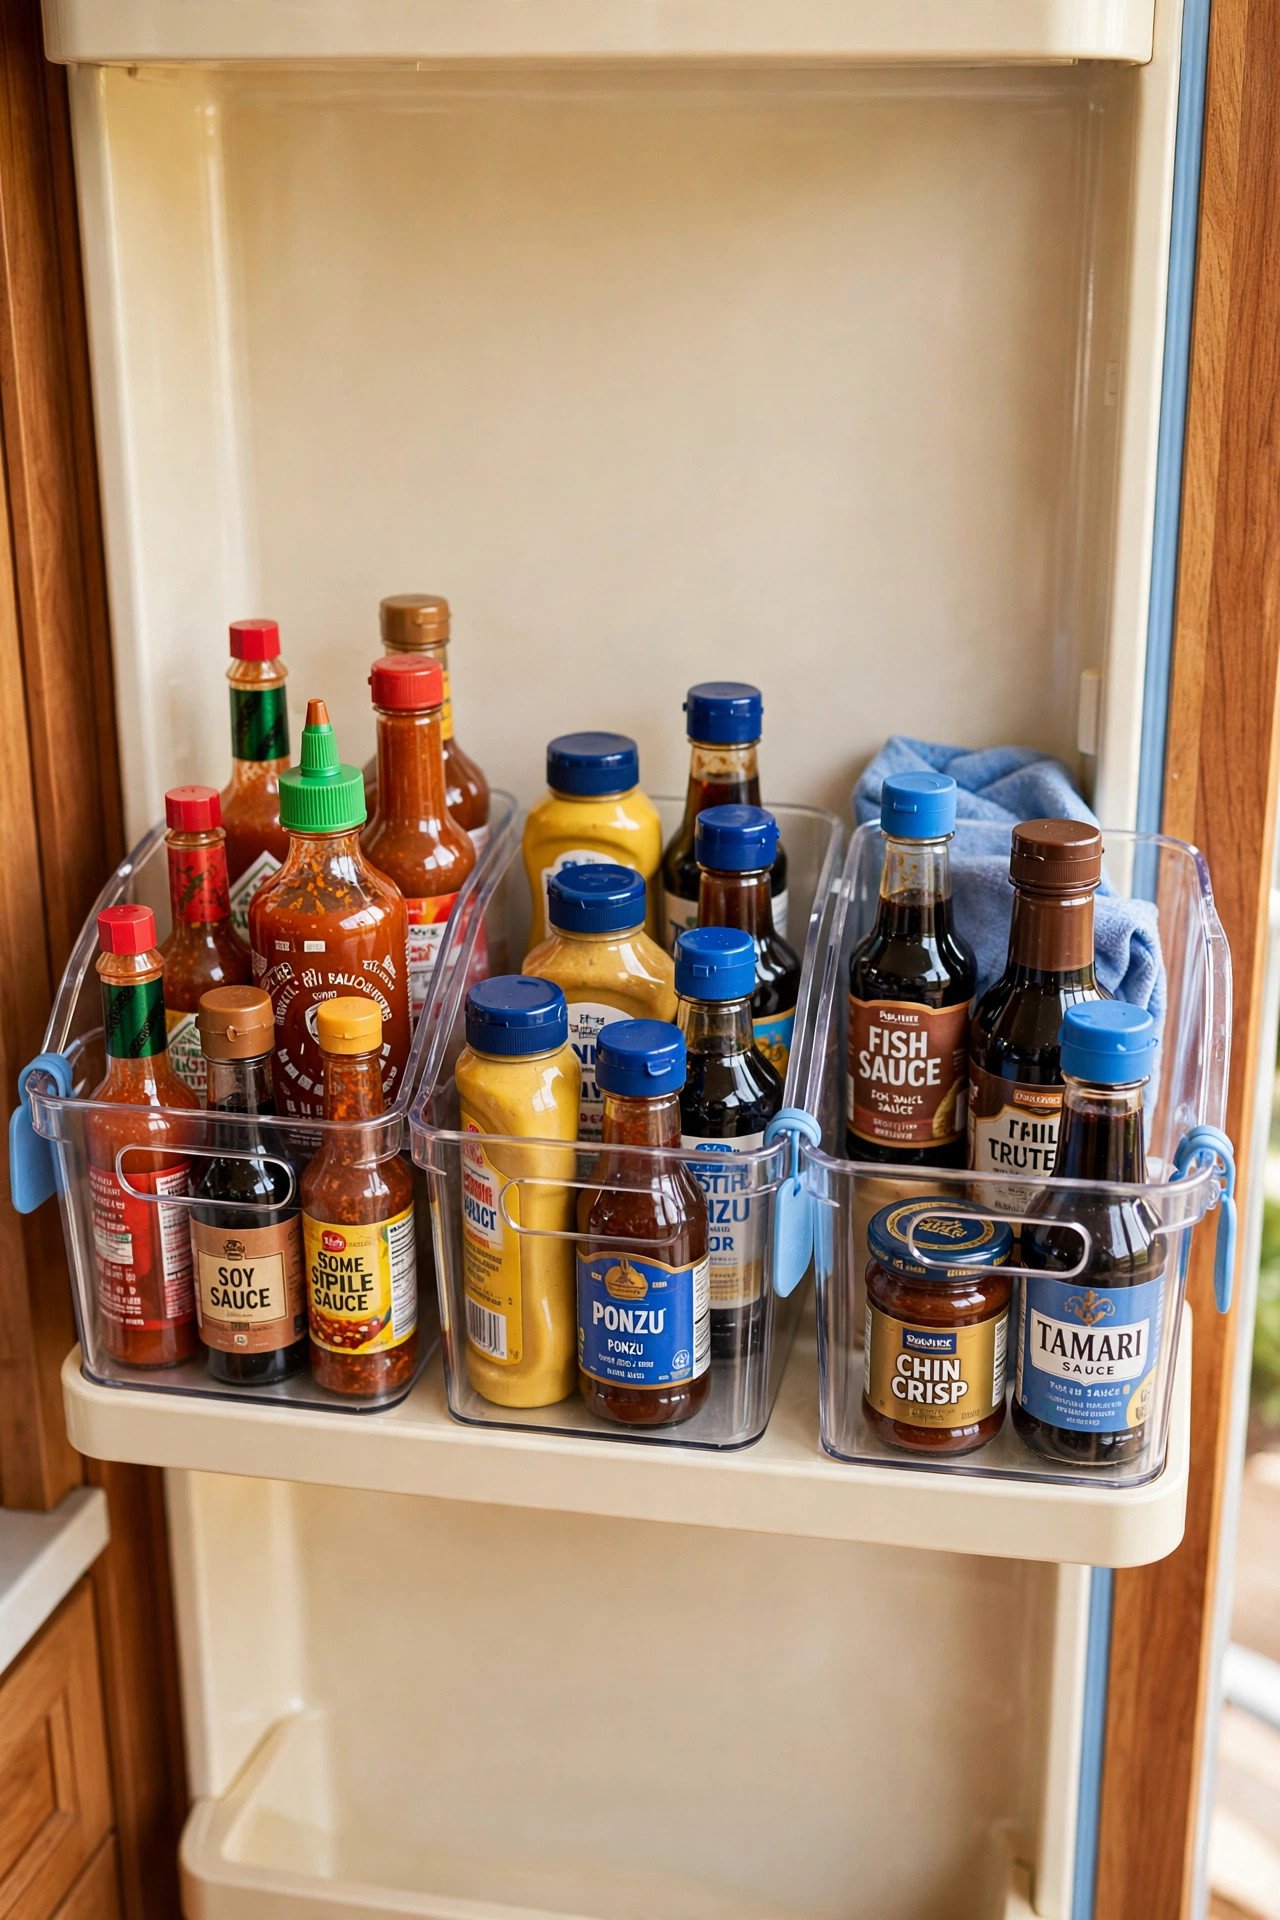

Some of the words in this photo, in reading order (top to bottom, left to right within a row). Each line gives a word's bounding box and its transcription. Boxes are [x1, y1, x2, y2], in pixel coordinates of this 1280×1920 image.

[869, 1025, 928, 1058] FISH
[859, 1050, 942, 1087] SAUCE
[317, 1251, 364, 1273] SOME
[217, 1266, 255, 1288] SOY
[210, 1286, 271, 1310] SAUCE
[314, 1287, 369, 1312] SAUCE
[592, 1300, 667, 1335] PONZU
[607, 1338, 644, 1356] PONZU
[1037, 1319, 1142, 1362] TAMARI
[895, 1353, 962, 1382] CHIN
[1062, 1361, 1115, 1376] SAUCE
[890, 1375, 969, 1405] CRISP
